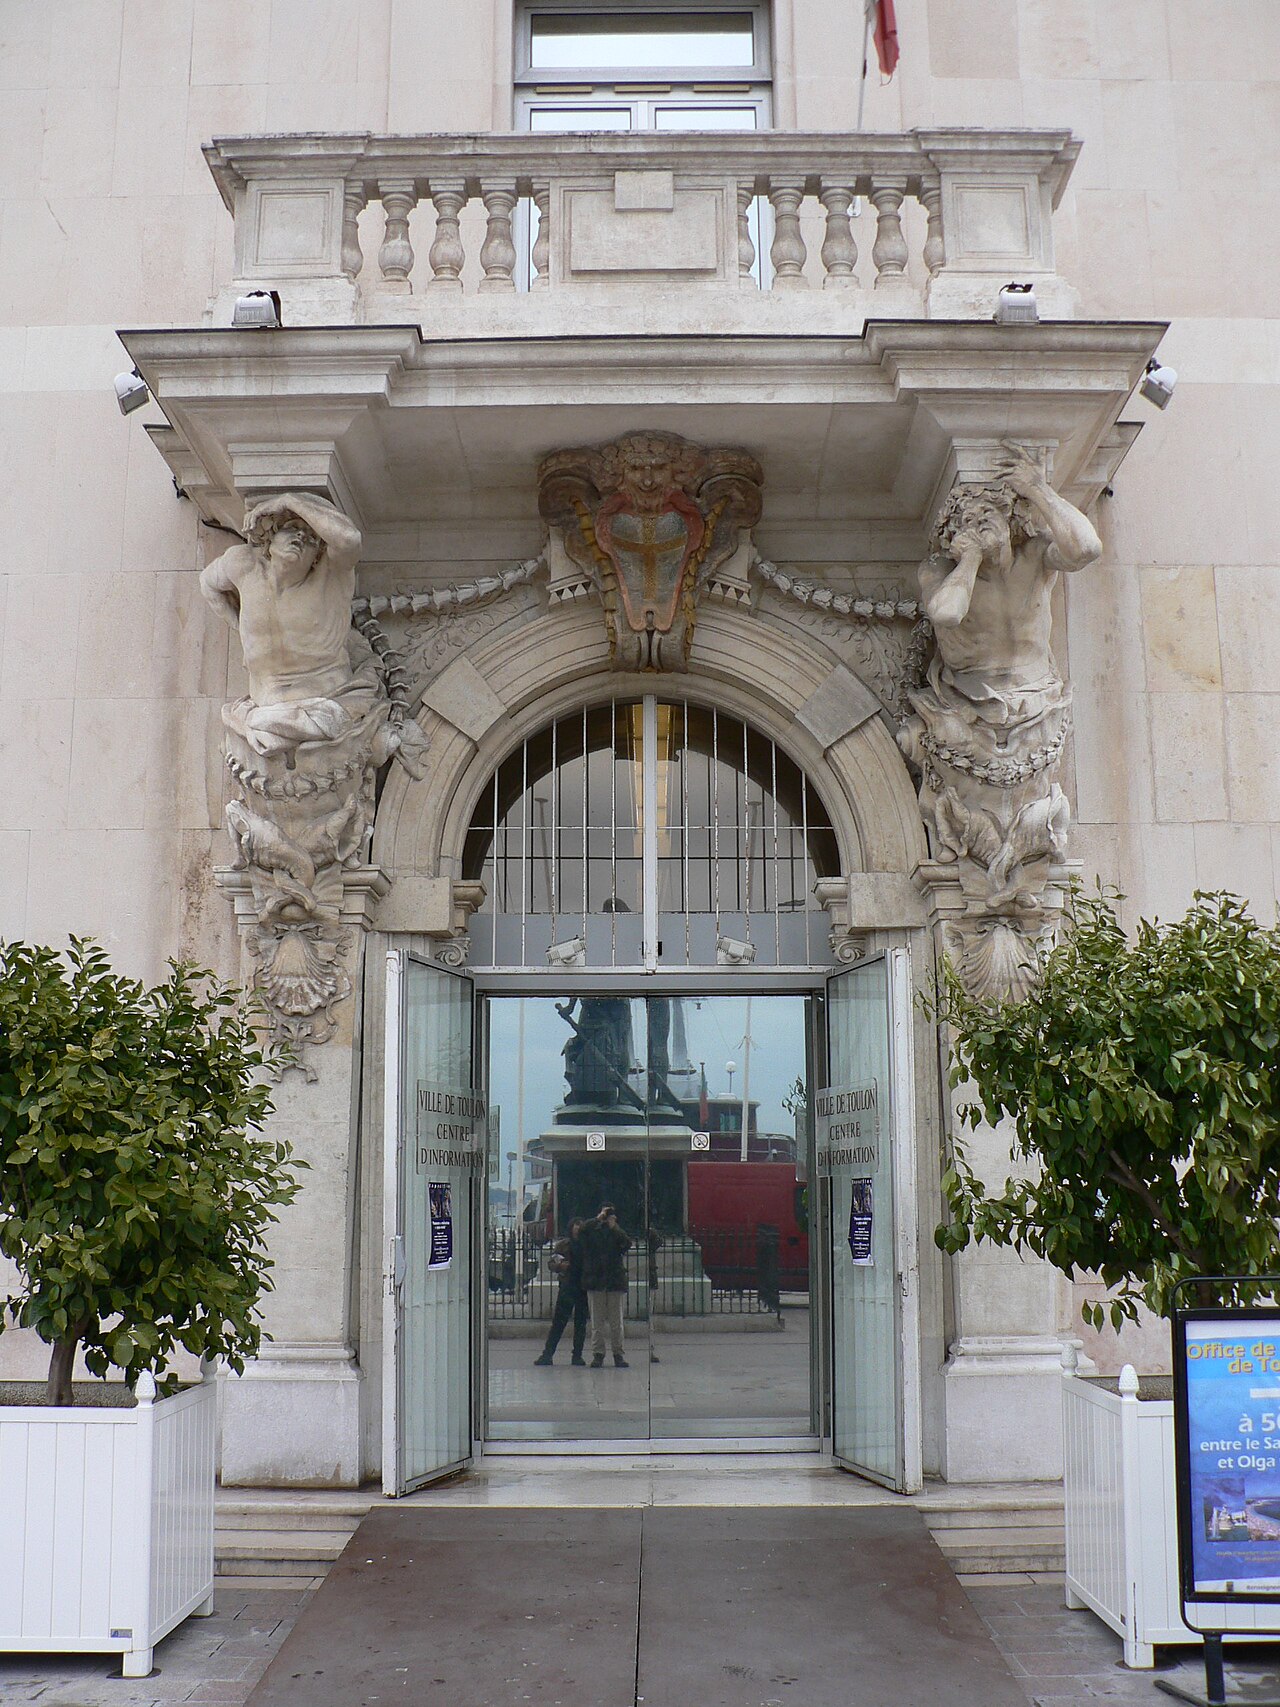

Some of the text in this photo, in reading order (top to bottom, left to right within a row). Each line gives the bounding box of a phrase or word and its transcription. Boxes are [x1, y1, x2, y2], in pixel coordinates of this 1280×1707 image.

[420, 1090, 486, 1119] VILLE DE TOULON
[816, 1088, 875, 1117] VILLE DE TOULON
[437, 1123, 470, 1141] CENTRE
[830, 1121, 861, 1140] CENTRE
[421, 1147, 484, 1168] D'INFORMATION
[817, 1145, 875, 1166] D'INFORMATION
[1187, 1341, 1276, 1359] Office de
[1228, 1358, 1253, 1374] de
[1239, 1413, 1280, 1432] à 5
[1200, 1438, 1242, 1451] entre
[1246, 1437, 1260, 1450] le
[1218, 1456, 1234, 1468] et
[1237, 1455, 1276, 1471] Olga
